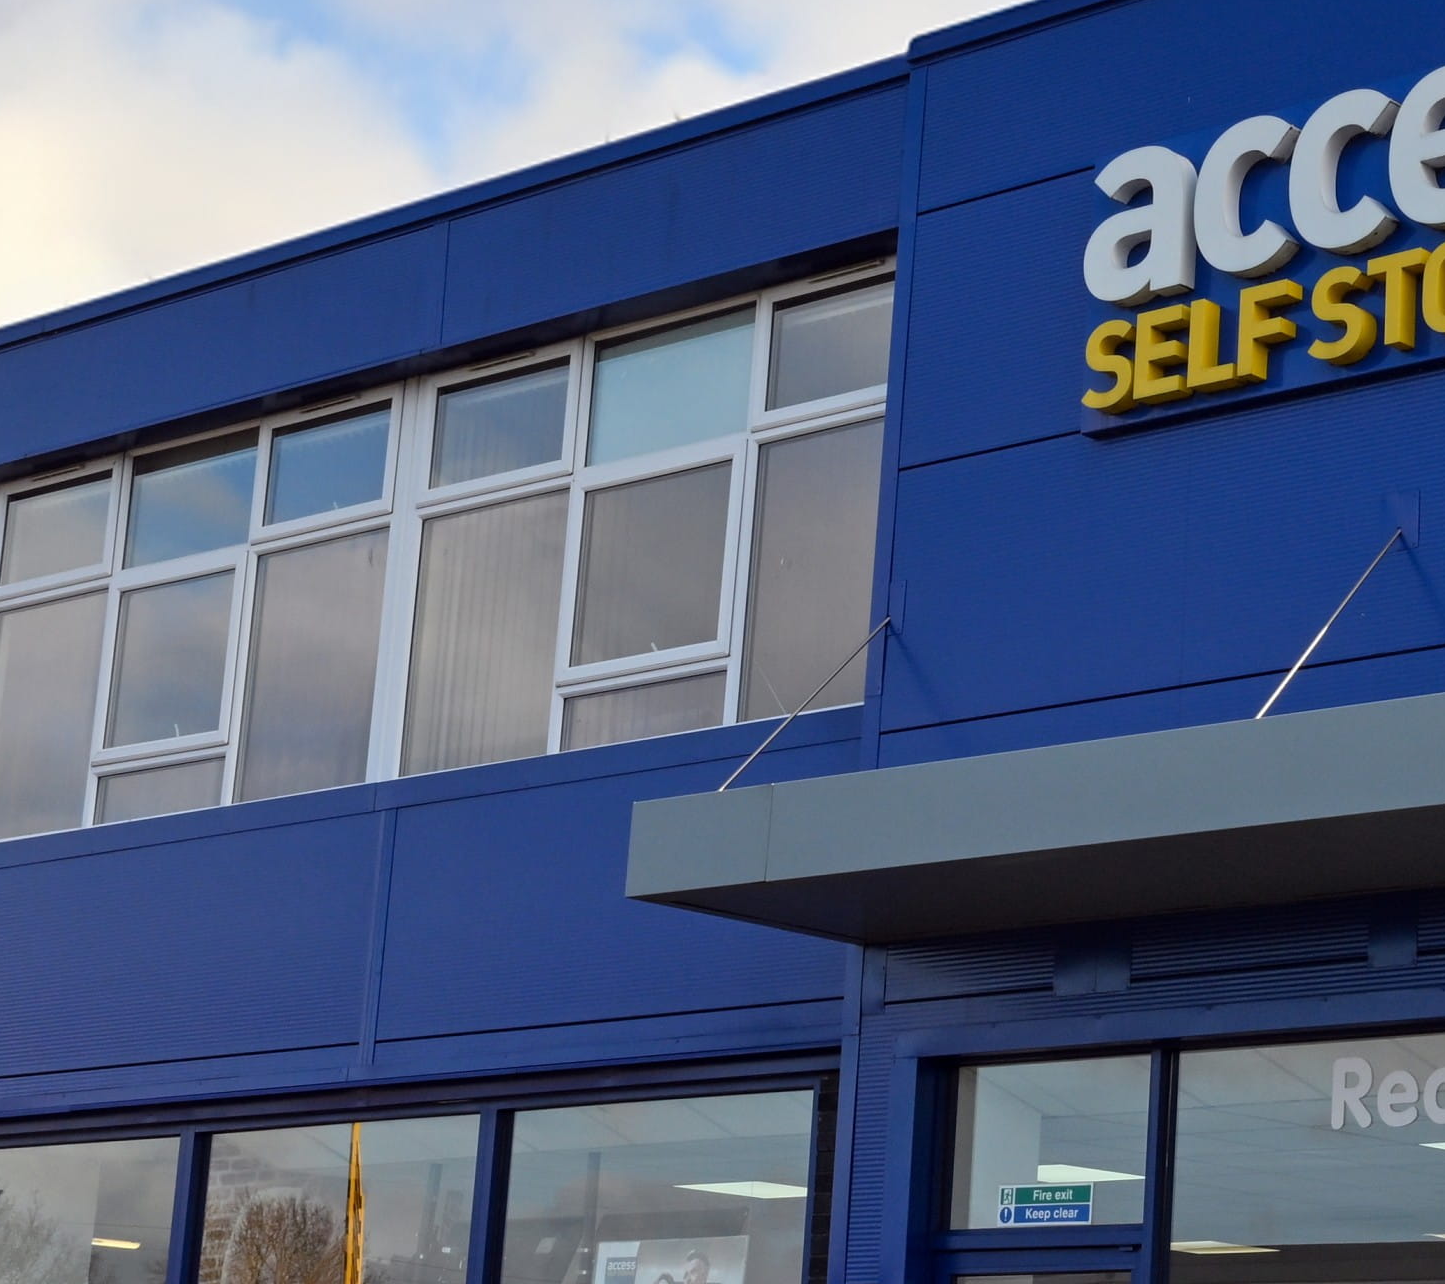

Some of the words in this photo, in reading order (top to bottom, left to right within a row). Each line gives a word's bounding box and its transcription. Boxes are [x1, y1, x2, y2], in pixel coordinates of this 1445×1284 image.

[1081, 277, 1304, 416] SELF
[1033, 1190, 1052, 1201] Fire
[1055, 1189, 1073, 1200] exit
[1025, 1208, 1051, 1221] Keep
[1053, 1207, 1078, 1219] clear
[607, 1261, 637, 1270] access
